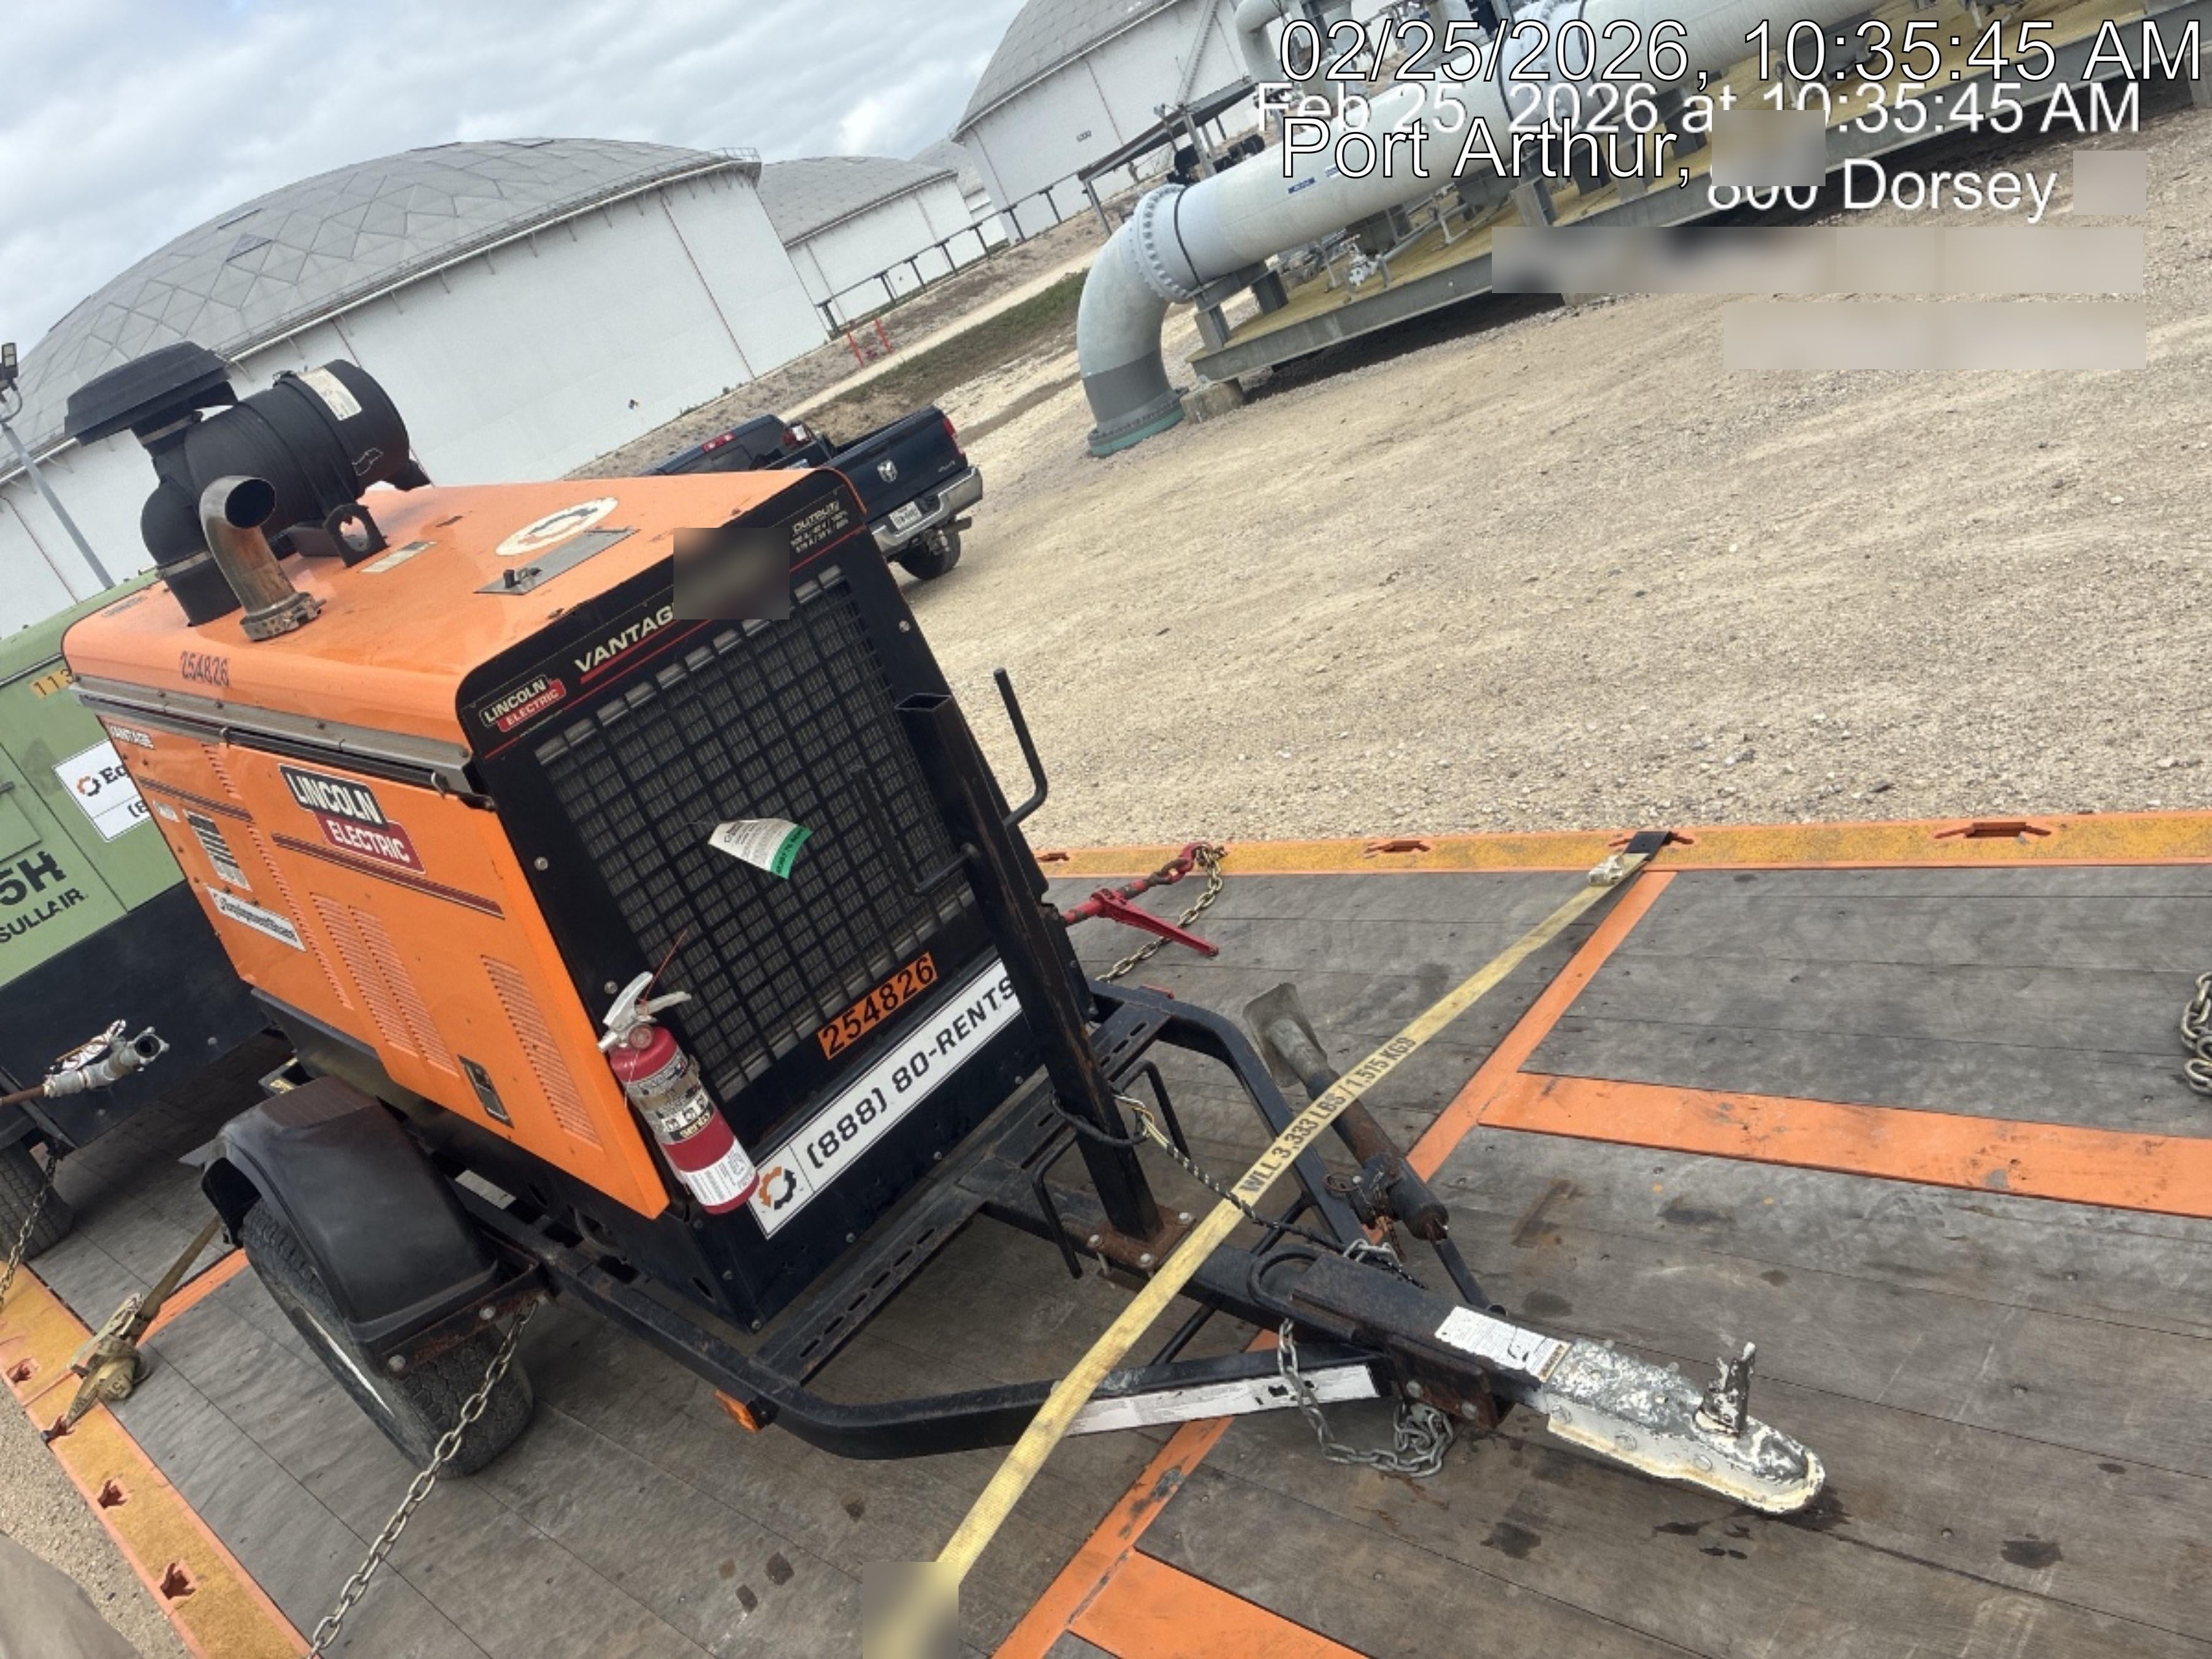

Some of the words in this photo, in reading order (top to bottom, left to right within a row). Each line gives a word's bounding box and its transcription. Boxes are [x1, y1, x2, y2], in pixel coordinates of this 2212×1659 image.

[575, 602, 673, 672] VANTAG
[484, 679, 546, 723] LINCOLN
[506, 689, 559, 724] ELECTRIC
[286, 773, 382, 824] LINCOLN
[326, 820, 410, 863] ELECTRIC
[823, 957, 933, 1054] 254826
[807, 1088, 887, 1169] (888)
[892, 976, 1014, 1093] 80-RENTS
[1238, 1163, 1282, 1192] WLL
[1313, 1092, 1347, 1120] LBS
[1384, 1037, 1416, 1061] KGS
